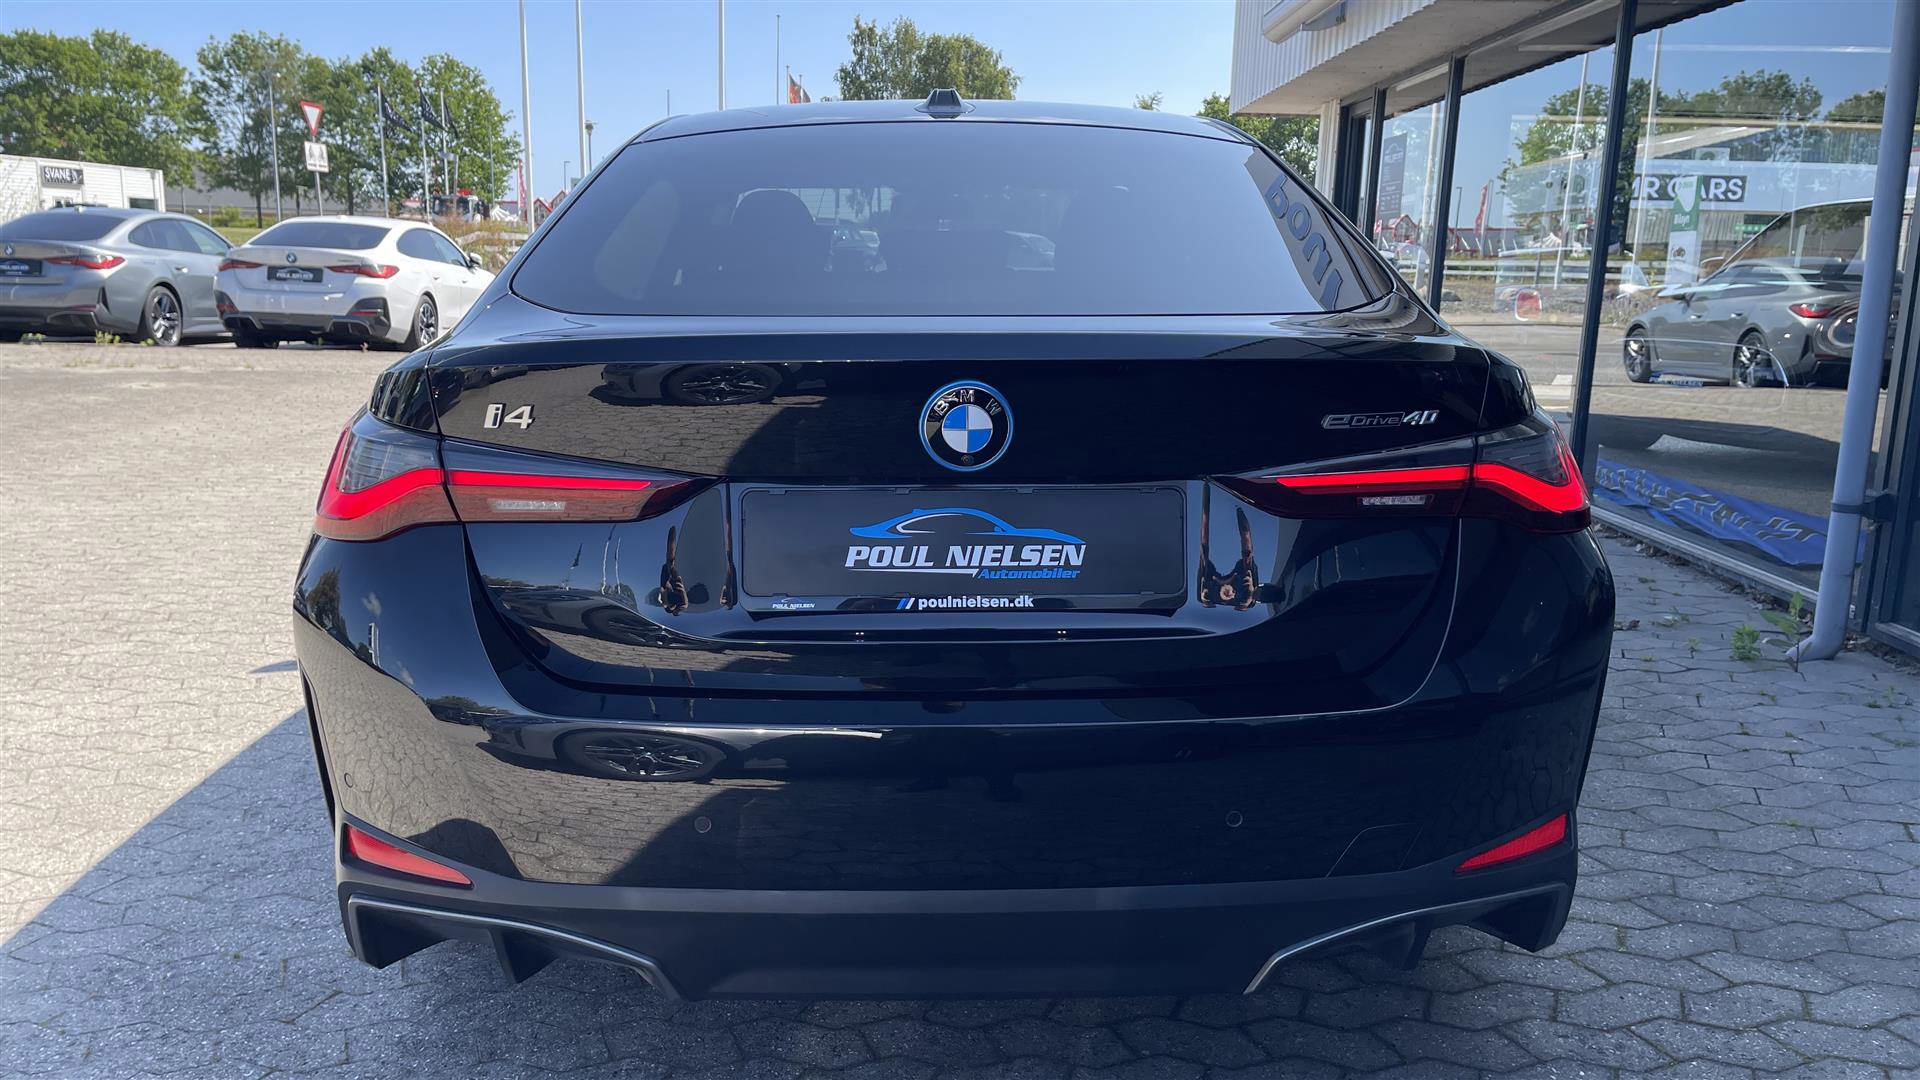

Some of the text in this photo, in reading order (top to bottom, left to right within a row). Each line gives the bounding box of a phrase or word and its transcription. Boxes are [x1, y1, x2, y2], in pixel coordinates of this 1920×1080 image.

[934, 388, 1002, 417] BMW
[484, 403, 534, 429] i4
[845, 544, 1087, 568] POUL NIELSEN
[977, 568, 1081, 580] Automobiler
[918, 595, 1034, 610] poulnielsen.dk
